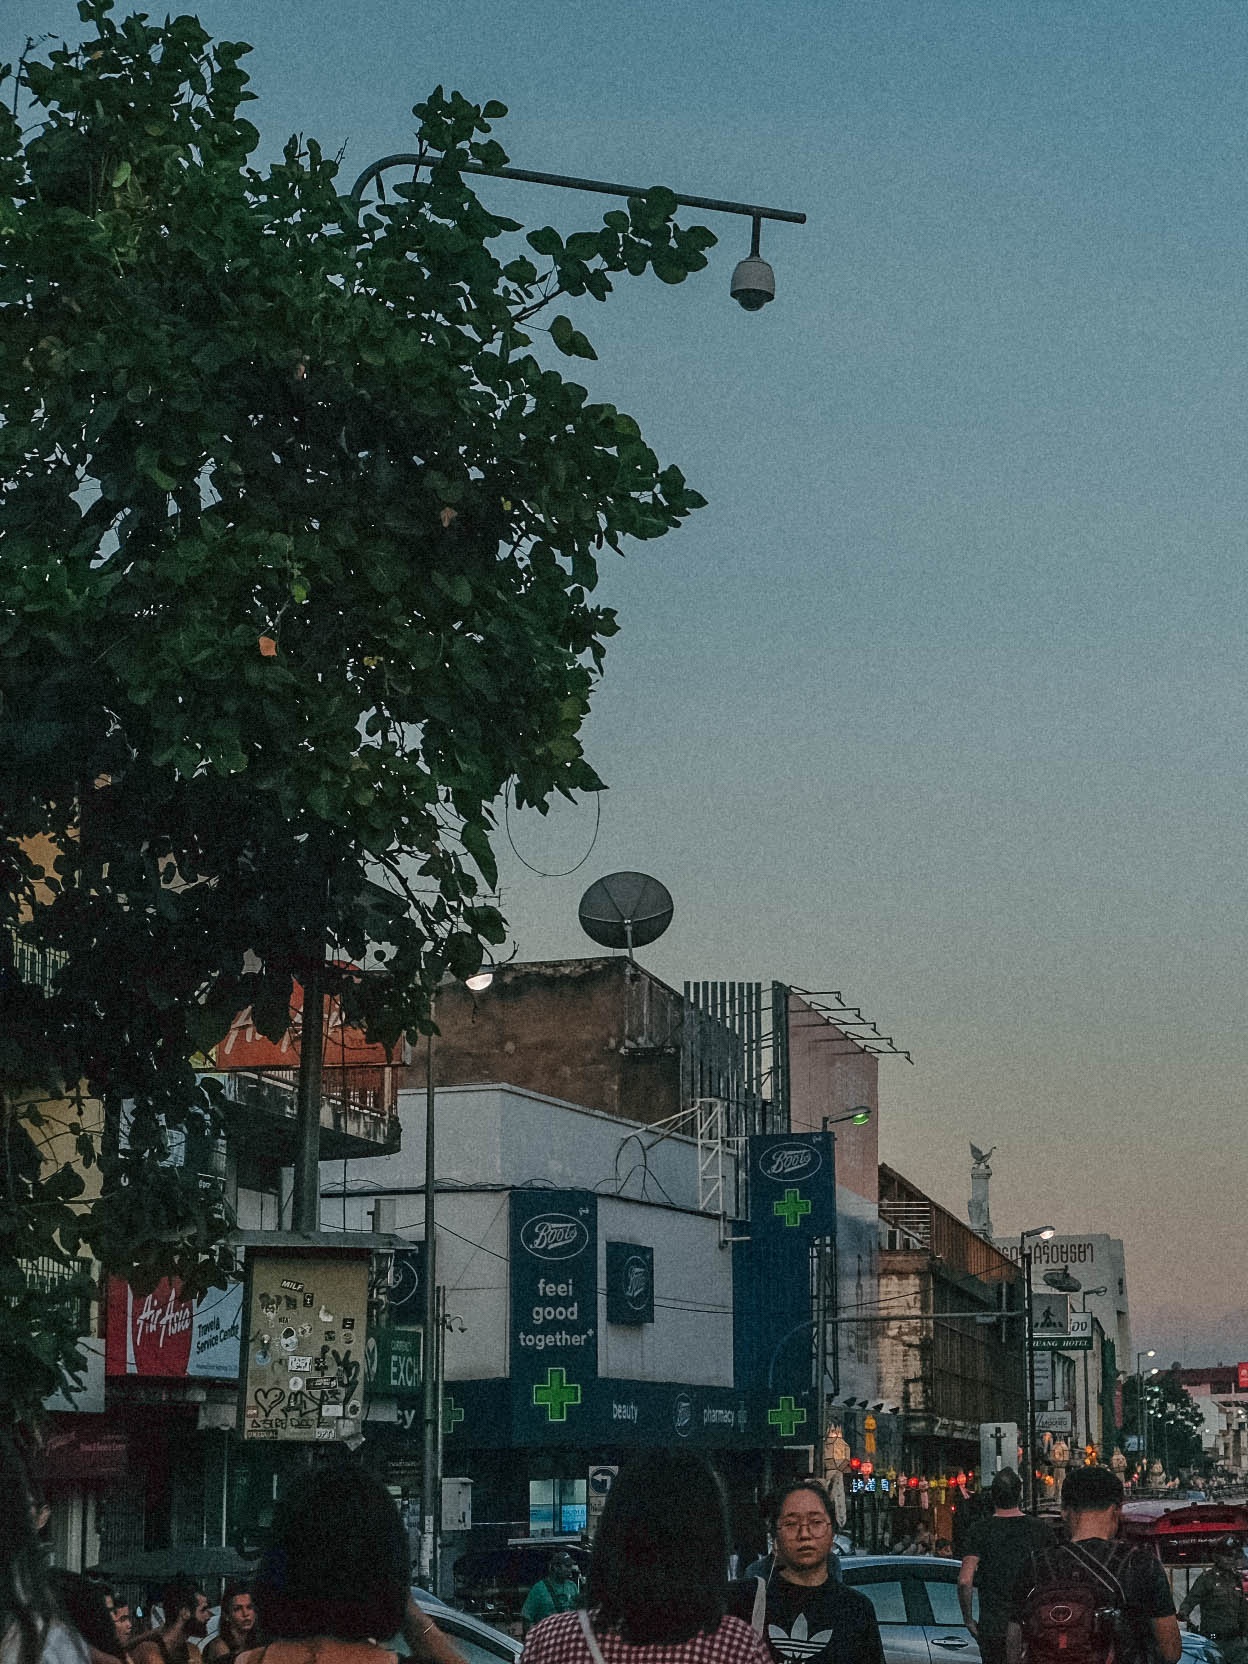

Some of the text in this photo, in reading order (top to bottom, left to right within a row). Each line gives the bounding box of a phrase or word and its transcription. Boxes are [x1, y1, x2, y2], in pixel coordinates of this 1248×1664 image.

[530, 1222, 578, 1250] Boots
[532, 1301, 578, 1325] good
[612, 1400, 639, 1424] beauty
[703, 1407, 735, 1427] pharmacy
